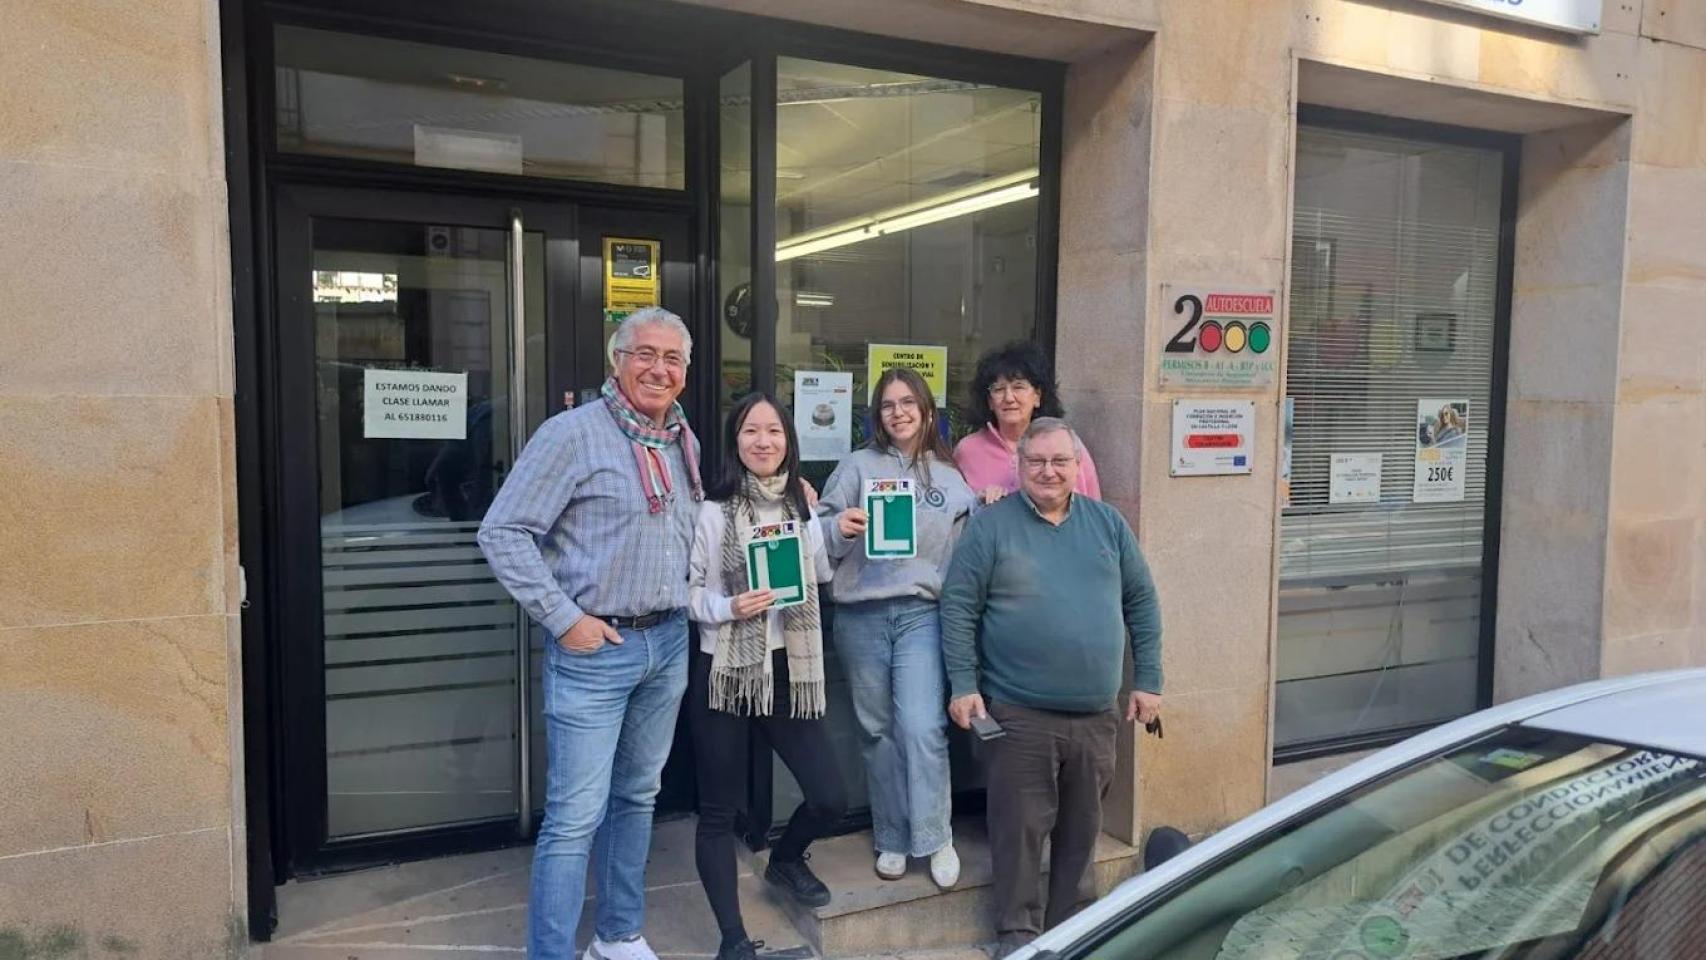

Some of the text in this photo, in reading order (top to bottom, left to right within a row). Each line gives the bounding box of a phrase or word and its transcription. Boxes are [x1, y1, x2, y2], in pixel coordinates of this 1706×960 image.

[1206, 296, 1272, 313] AUTOESCUELA
[892, 352, 915, 360] CENTRO
[1163, 359, 1200, 369] PERMISOS
[375, 382, 457, 394] ESTAMOS DANDO
[382, 397, 450, 407] CLASE LLAMAR
[384, 413, 448, 422] AL 651880116
[1427, 466, 1454, 482] 250€
[872, 499, 911, 551] L
[754, 546, 800, 600] L
